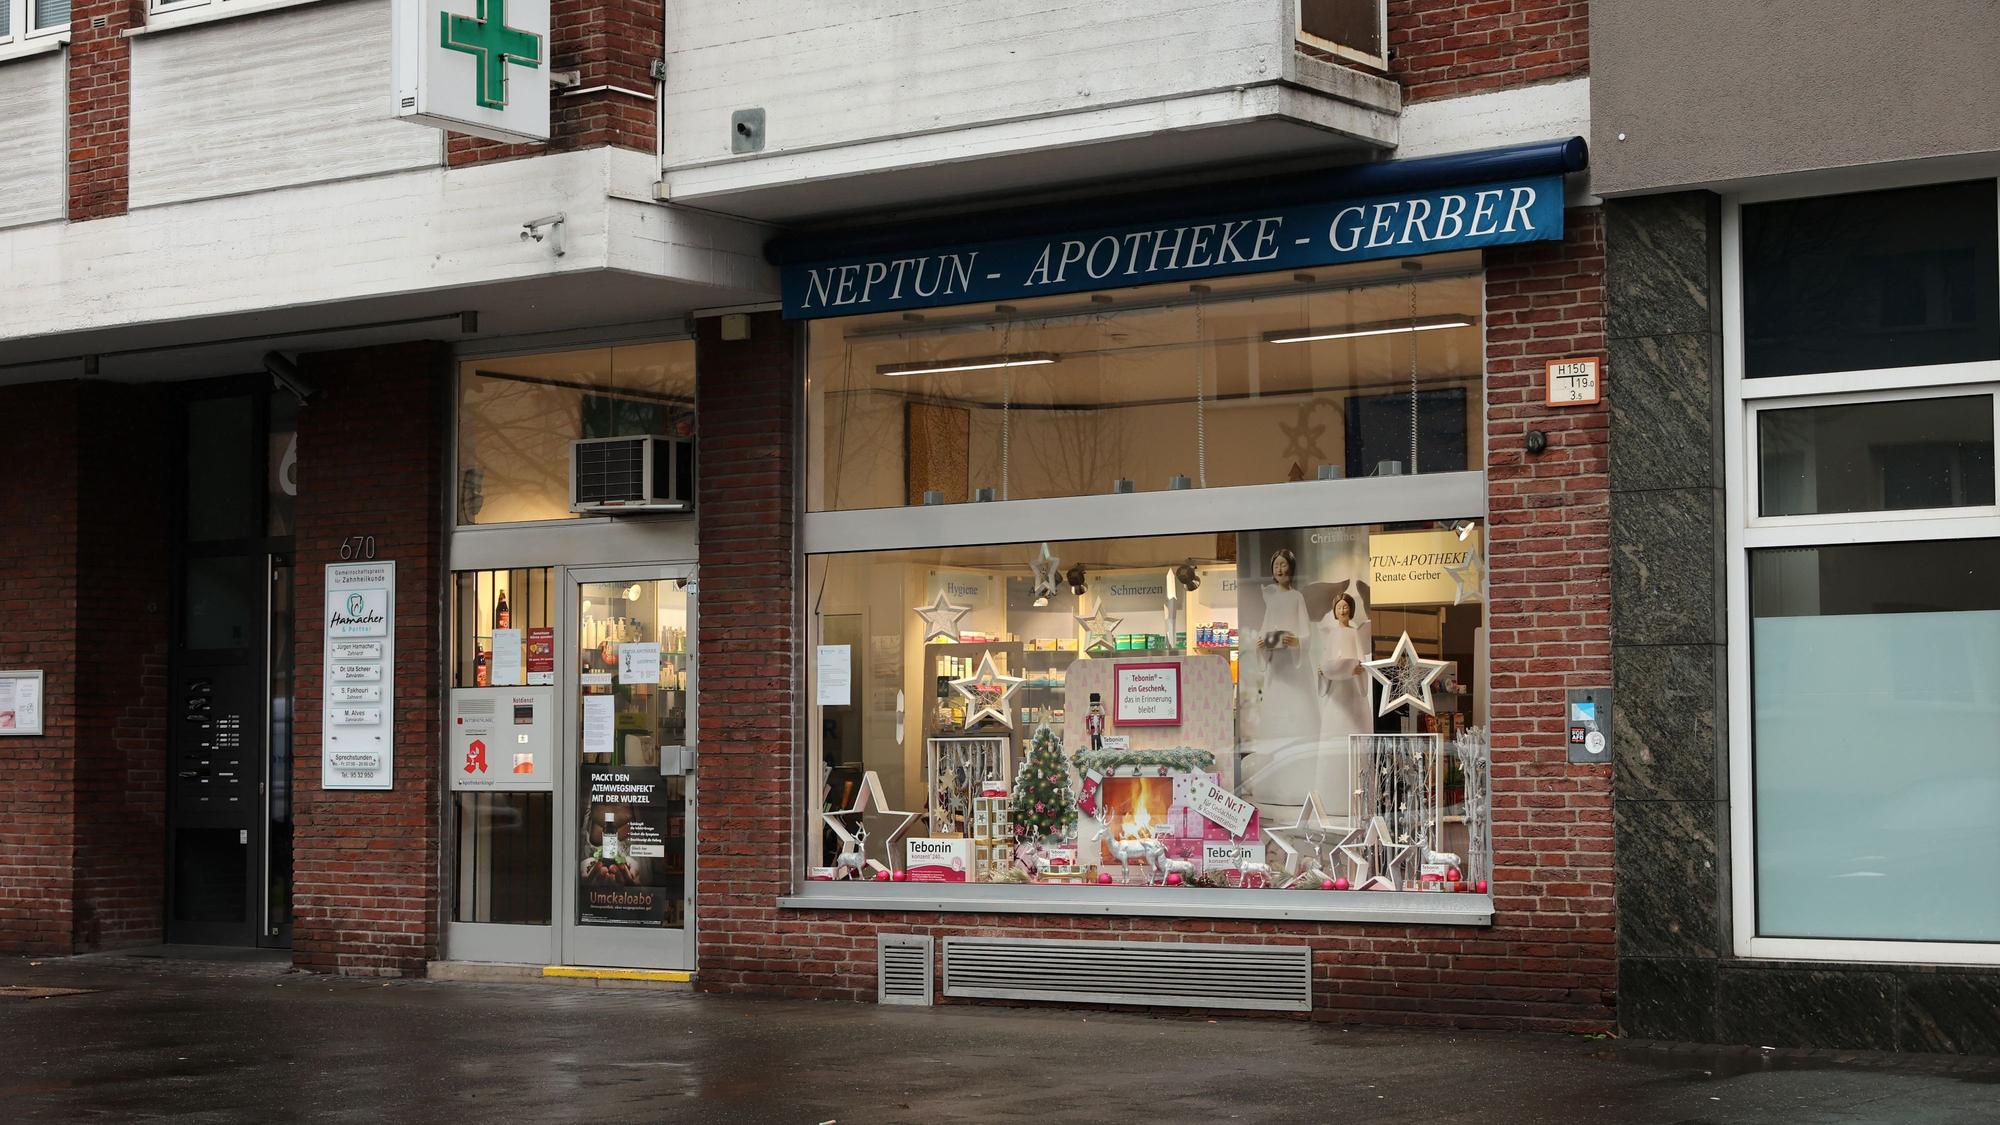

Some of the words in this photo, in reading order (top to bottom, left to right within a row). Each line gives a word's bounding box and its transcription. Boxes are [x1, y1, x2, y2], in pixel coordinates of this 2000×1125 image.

[801, 251, 979, 309] NEPTUN
[1023, 216, 1283, 287] APOTHEKE
[1328, 186, 1537, 252] GERBER
[1311, 532, 1360, 544] Christma
[341, 536, 375, 560] 670
[343, 575, 385, 583] Zahnheilkunde
[1375, 571, 1407, 582] Renate
[1408, 570, 1441, 581] Gerber
[947, 582, 978, 597] Hygiene
[1110, 584, 1163, 596] Schmerzen
[330, 609, 384, 628] Hamacher
[1138, 684, 1167, 693] Geschenk,
[1141, 696, 1172, 704] Erinnerung
[591, 773, 613, 782] PACKT
[614, 773, 630, 782] DEN
[592, 794, 604, 803] MIT
[605, 794, 619, 803] DER
[620, 795, 650, 804] WURZEL
[1208, 787, 1224, 803] Die
[910, 841, 951, 853] Tebonin
[1206, 847, 1251, 858] Teboin
[590, 891, 652, 905] Umckaloabo
